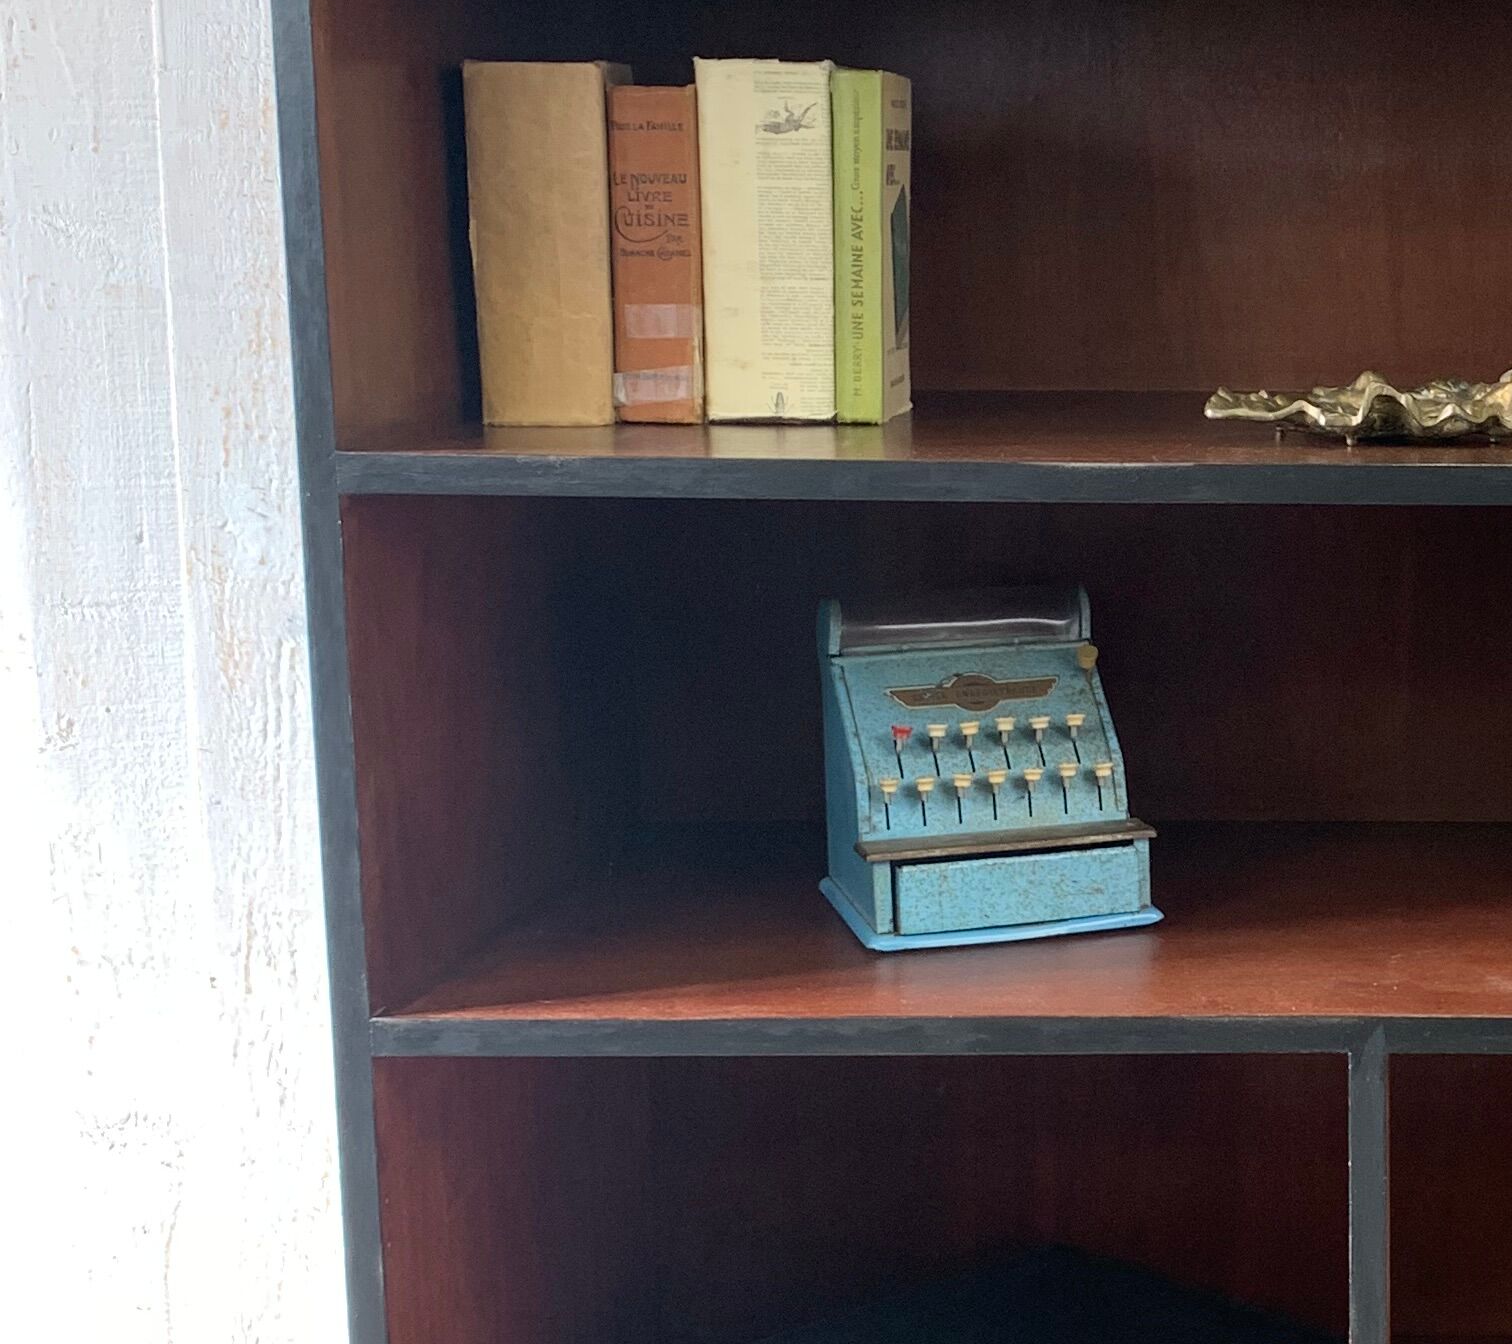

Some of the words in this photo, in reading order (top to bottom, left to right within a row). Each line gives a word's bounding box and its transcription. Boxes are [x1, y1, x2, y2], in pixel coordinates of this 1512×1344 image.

[613, 171, 628, 186] LE
[630, 173, 687, 190] NOUVEAU
[628, 191, 673, 202] LIVRE
[614, 206, 690, 243] CUISINE
[851, 245, 865, 307] SEMAINE
[851, 312, 864, 340] UNE
